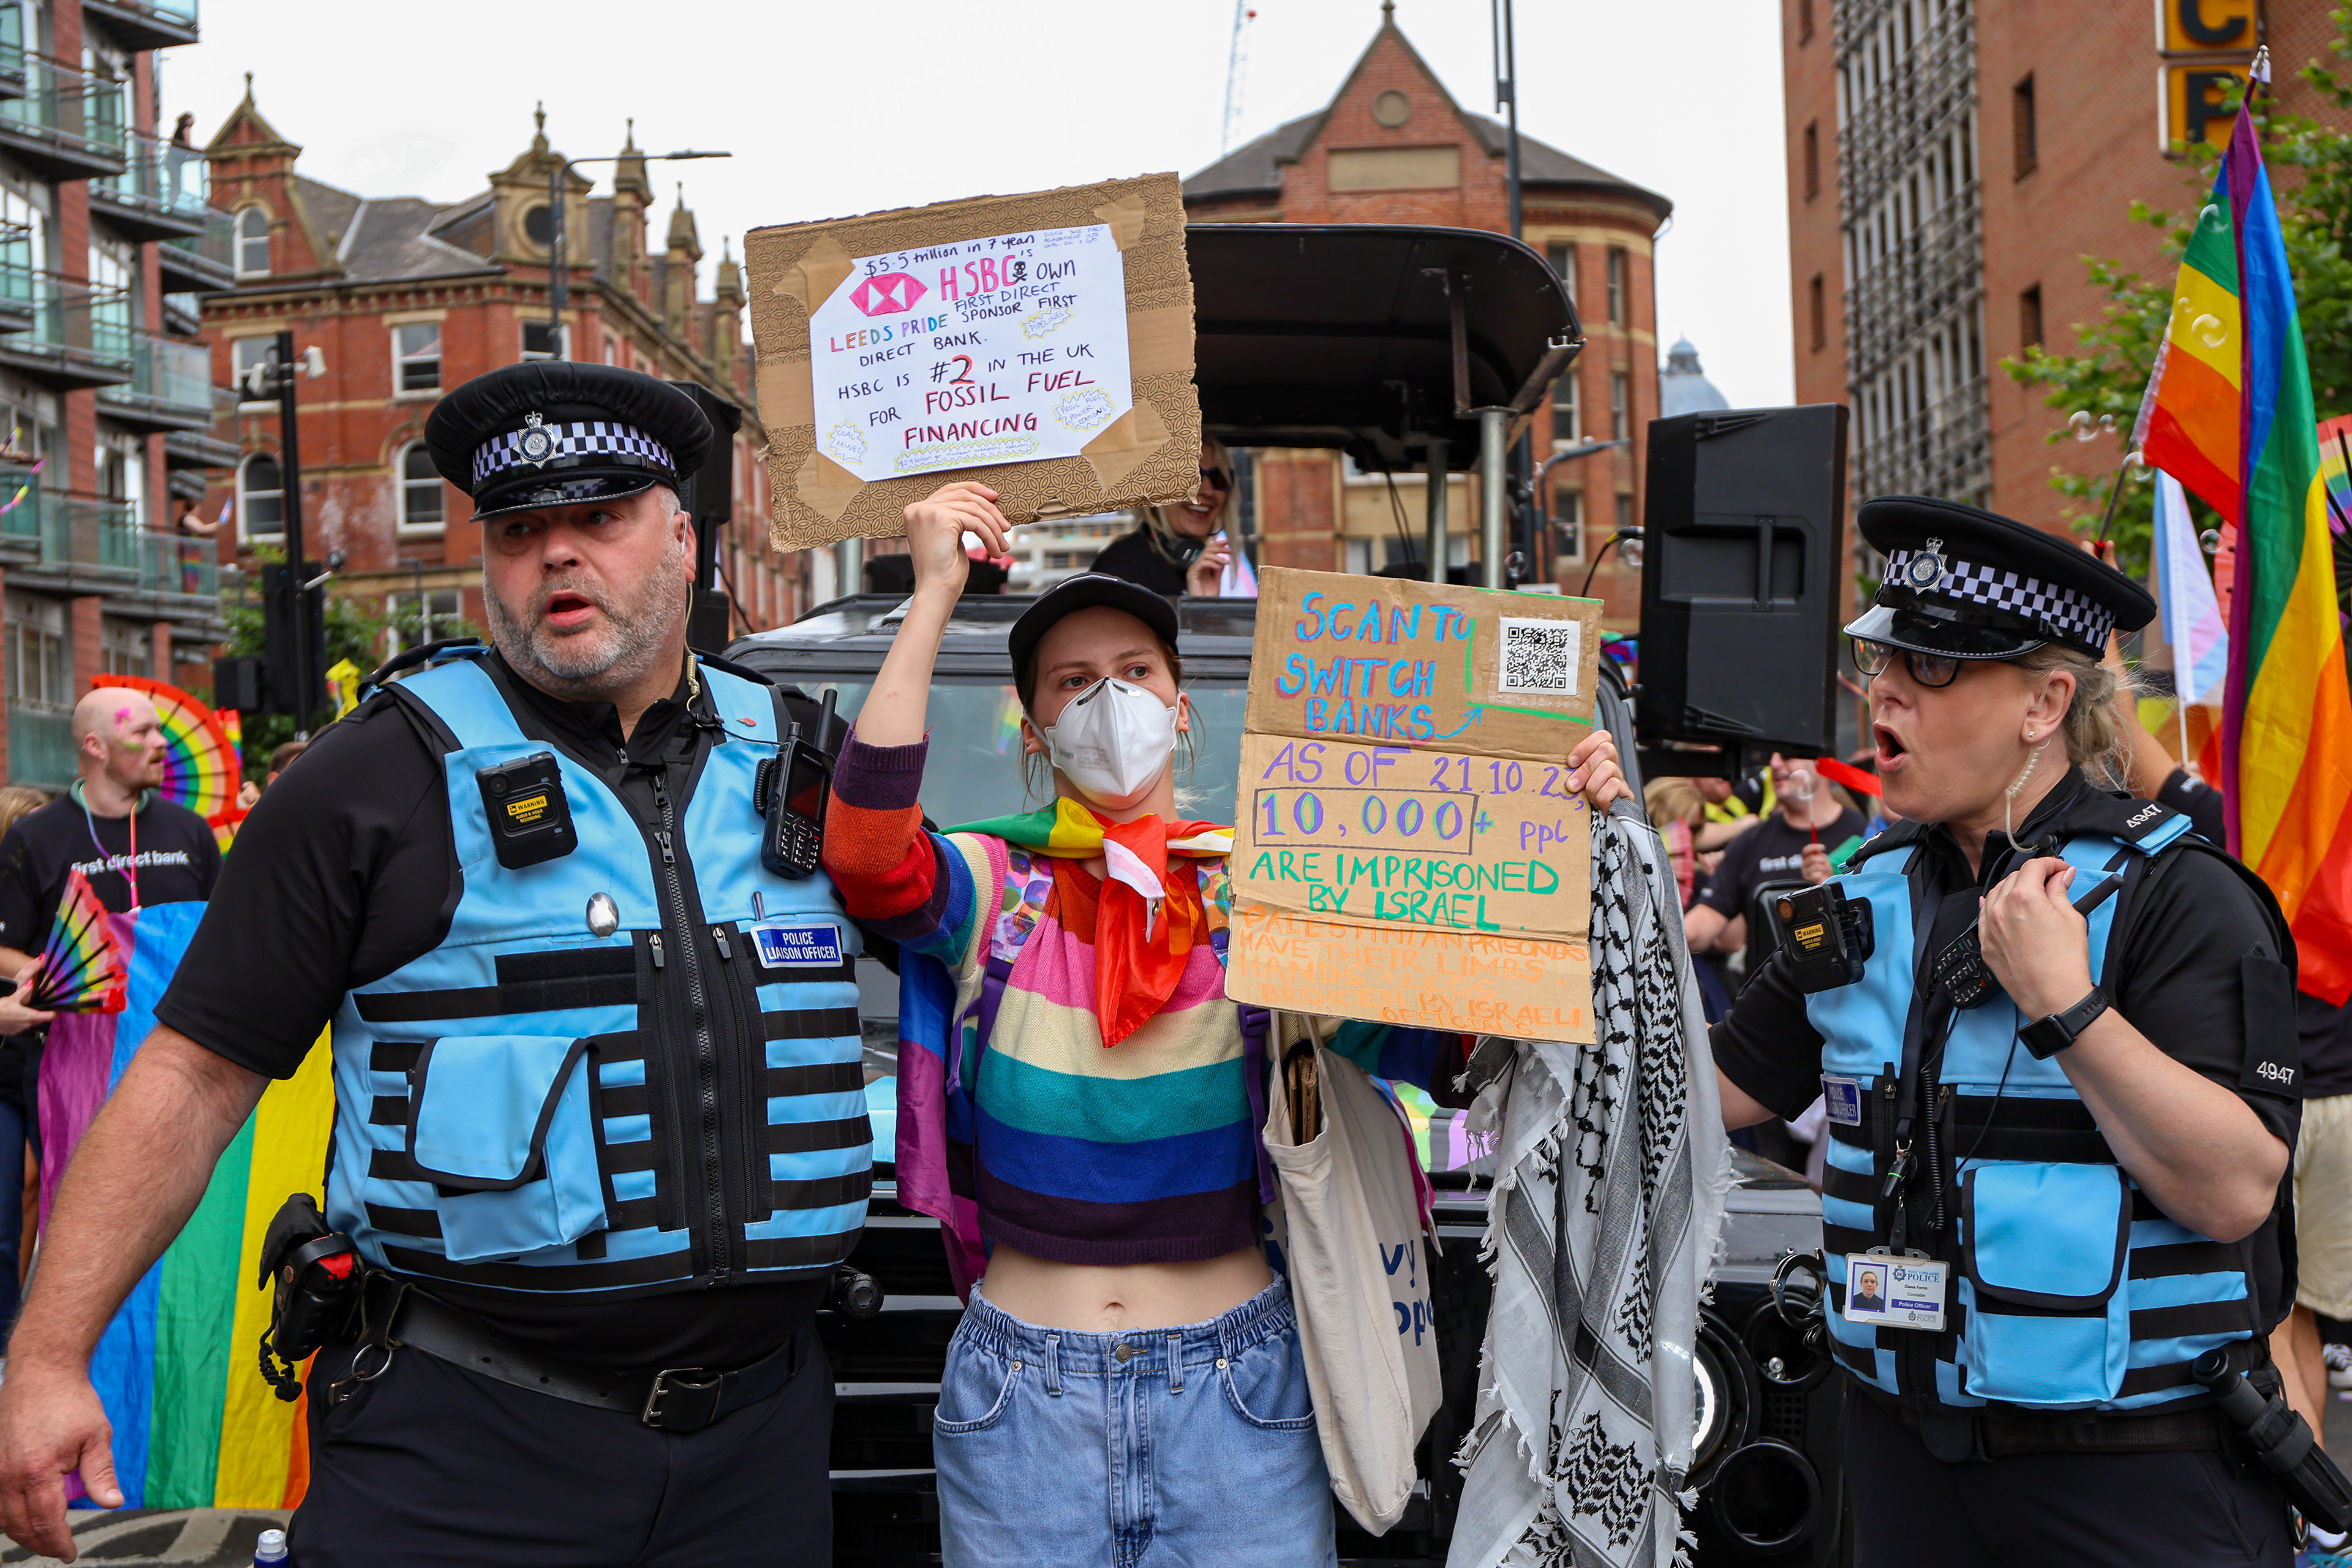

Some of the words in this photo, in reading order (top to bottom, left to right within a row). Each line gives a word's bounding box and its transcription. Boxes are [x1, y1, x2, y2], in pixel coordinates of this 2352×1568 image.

[913, 246, 958, 263] trillion
[967, 243, 981, 252] in
[988, 239, 998, 249] 7
[1036, 260, 1076, 280] OWN
[954, 294, 995, 312] FIRST
[1001, 282, 1060, 302] DIRECT
[831, 325, 892, 353] LEEDS
[902, 314, 948, 337] PRIDE
[961, 302, 1023, 323] SPONSOR
[1039, 295, 1077, 308] FIRST
[860, 342, 916, 367] DIRECT
[839, 379, 884, 399] HSBC
[896, 373, 910, 387] IS
[989, 359, 1006, 372] IN
[1017, 348, 1054, 365] THE
[1067, 344, 1094, 358] UK
[870, 407, 902, 426] FOR
[925, 383, 1011, 415] FOSSIL
[1027, 369, 1096, 393] FUEL
[836, 429, 856, 440] COAL
[904, 412, 1038, 449] FINANCING
[835, 440, 862, 454] MINES
[1294, 591, 1422, 644] SCAN
[1273, 652, 1436, 699] SWITCH
[1304, 696, 1436, 745] BANKS
[802, 753, 823, 766] MOTOROLA
[1262, 741, 1327, 783] AS
[1345, 745, 1411, 787] OF
[518, 799, 545, 810] WARNING
[2126, 804, 2162, 828] 4947
[520, 814, 541, 823] RECORDING
[152, 850, 190, 866] bank
[1759, 856, 1787, 873] first
[1249, 850, 1324, 882] ARE
[1336, 854, 1559, 894] IMPRISONED
[1309, 884, 1349, 914] BY
[782, 932, 815, 945] POLICE
[1243, 904, 1464, 949] PALESTINIAN
[1469, 932, 1587, 962] PRISONERS
[1803, 927, 1822, 937] WARNING
[766, 946, 802, 960] LIAISON
[802, 946, 837, 959] OFFICER
[1240, 929, 1310, 959] HAVE
[1319, 943, 1425, 971] THEIR
[1239, 952, 1366, 986] HANDS
[1401, 973, 1497, 1000] LEGS
[1260, 982, 1406, 1008] BROKEN
[1417, 991, 1458, 1016] BY
[1468, 999, 1583, 1028] ISRAELI
[2256, 1061, 2295, 1085] 4947
[1907, 1273, 1939, 1283] POLICE
